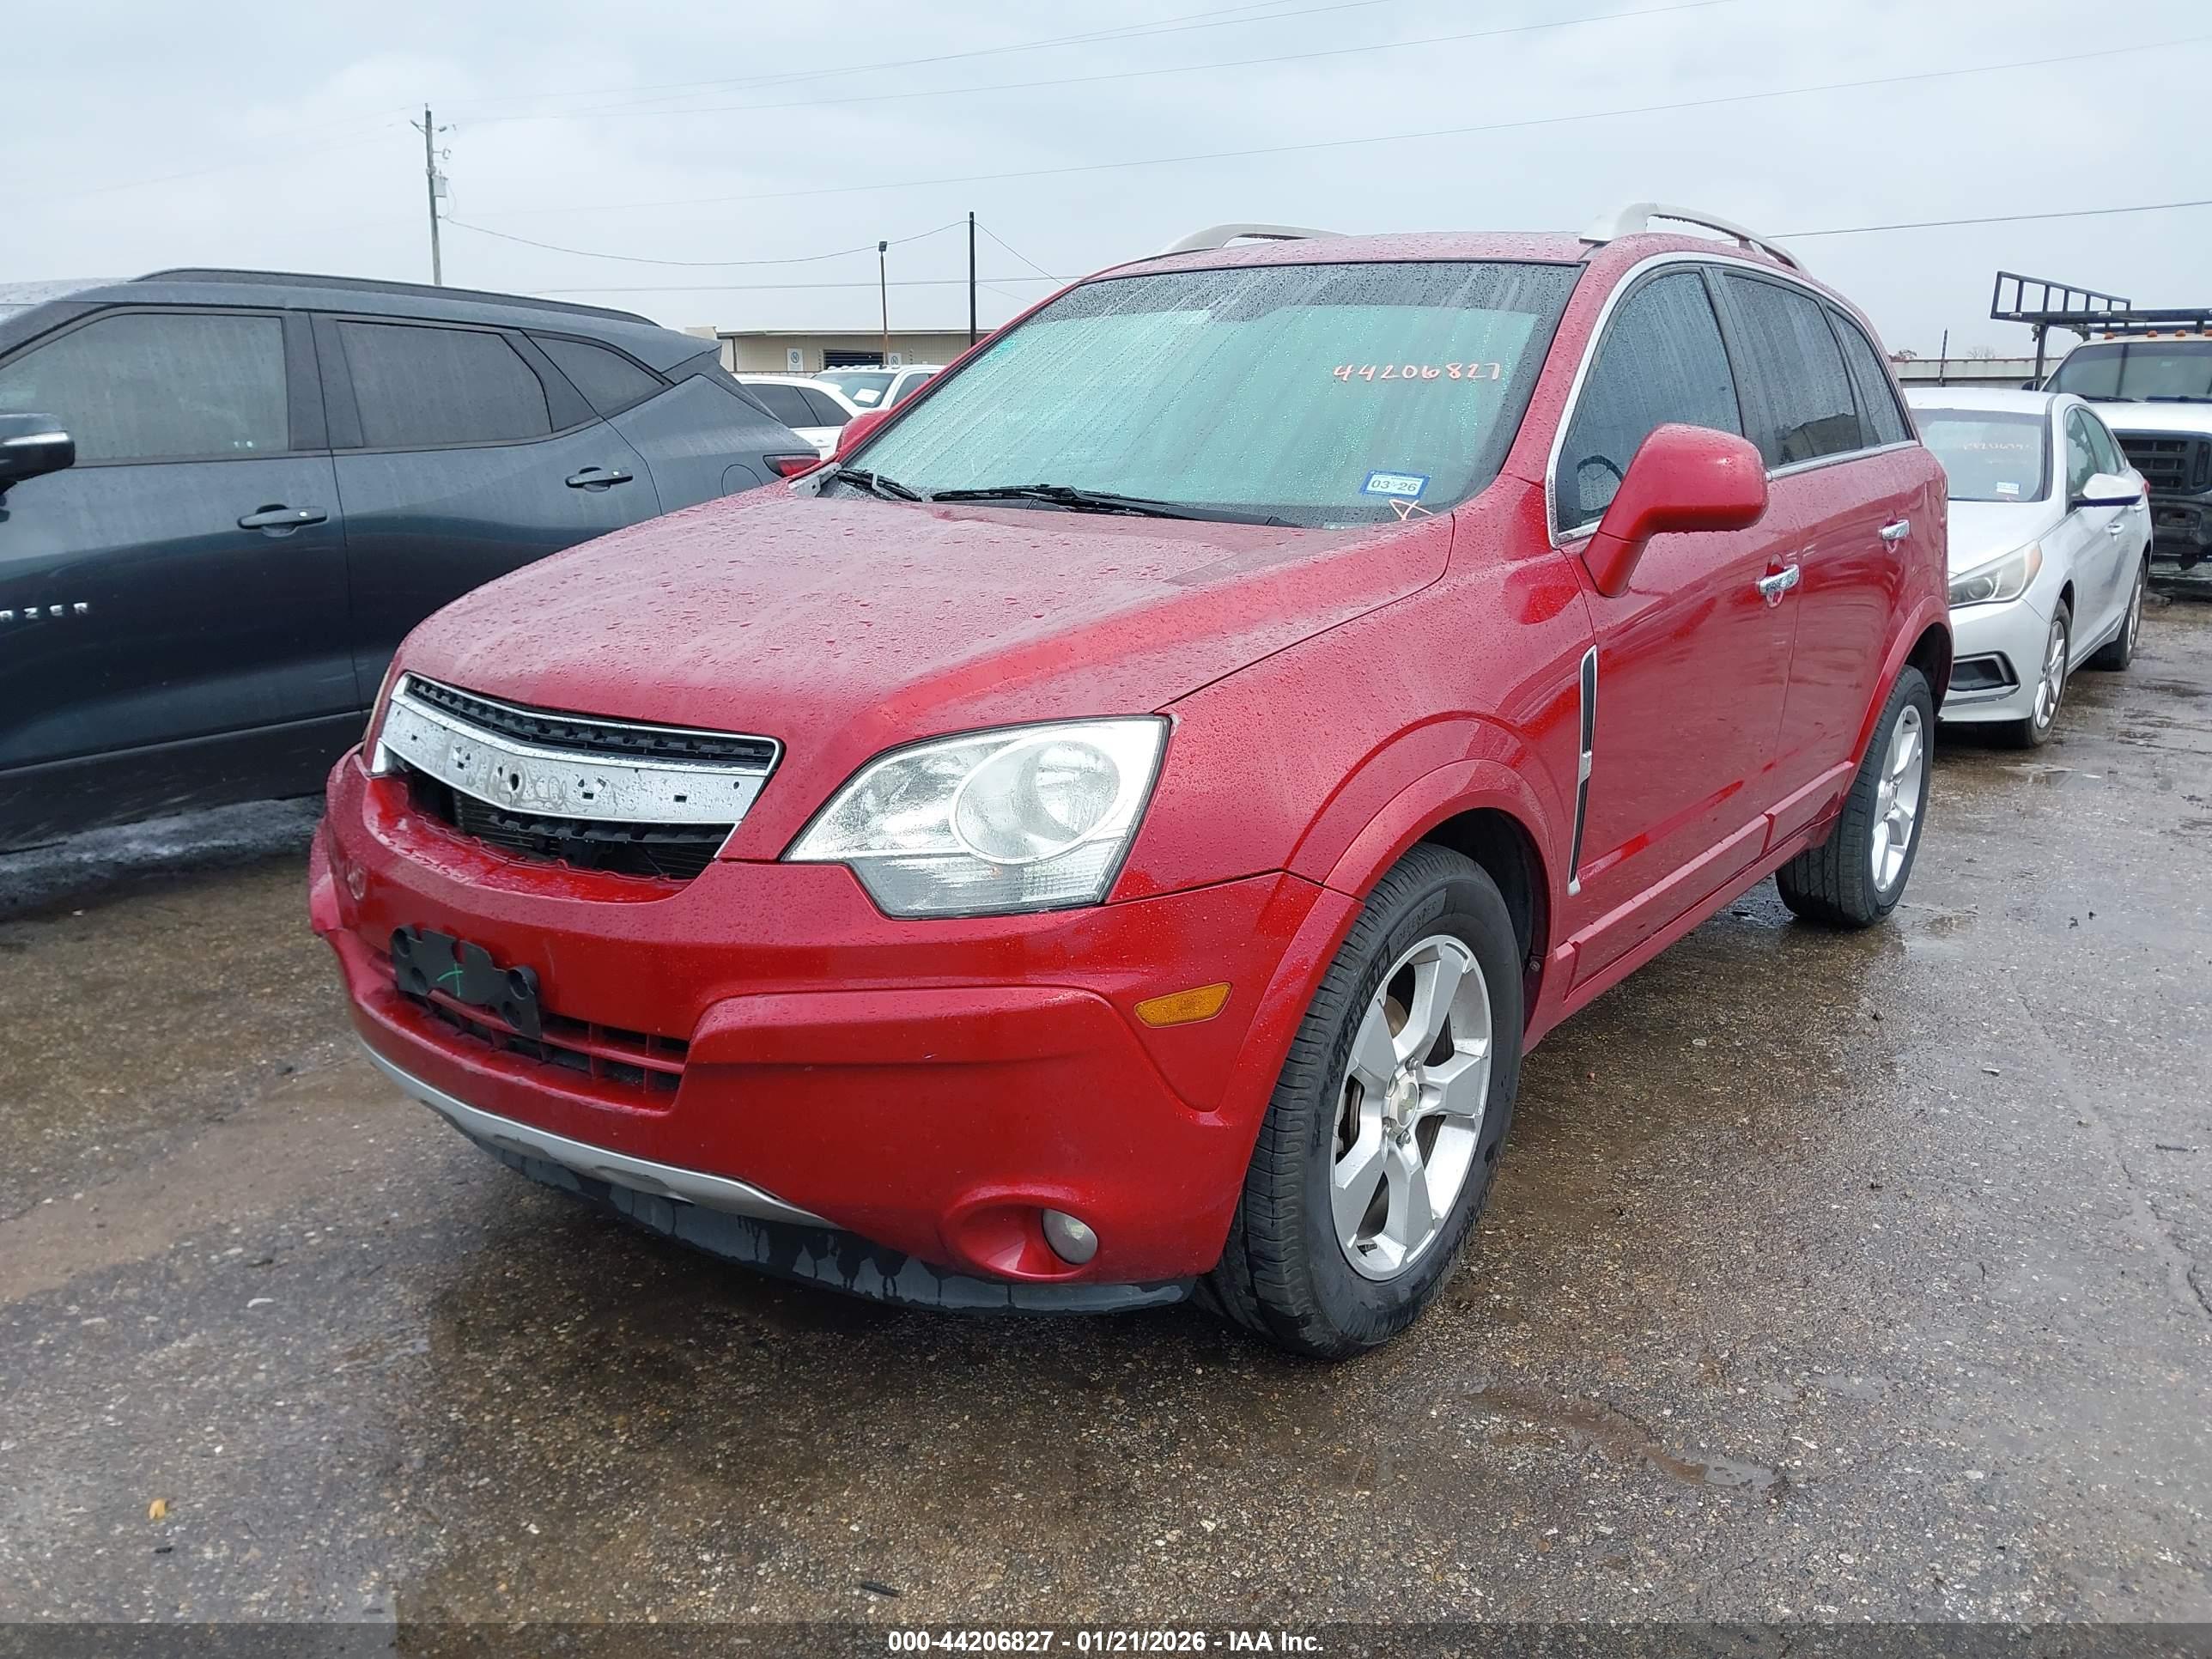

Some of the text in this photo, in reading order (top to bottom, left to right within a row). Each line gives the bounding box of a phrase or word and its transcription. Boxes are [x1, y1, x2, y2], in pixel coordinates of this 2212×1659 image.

[1333, 362, 1501, 382] 44206827
[1370, 479, 1419, 492] 03 26
